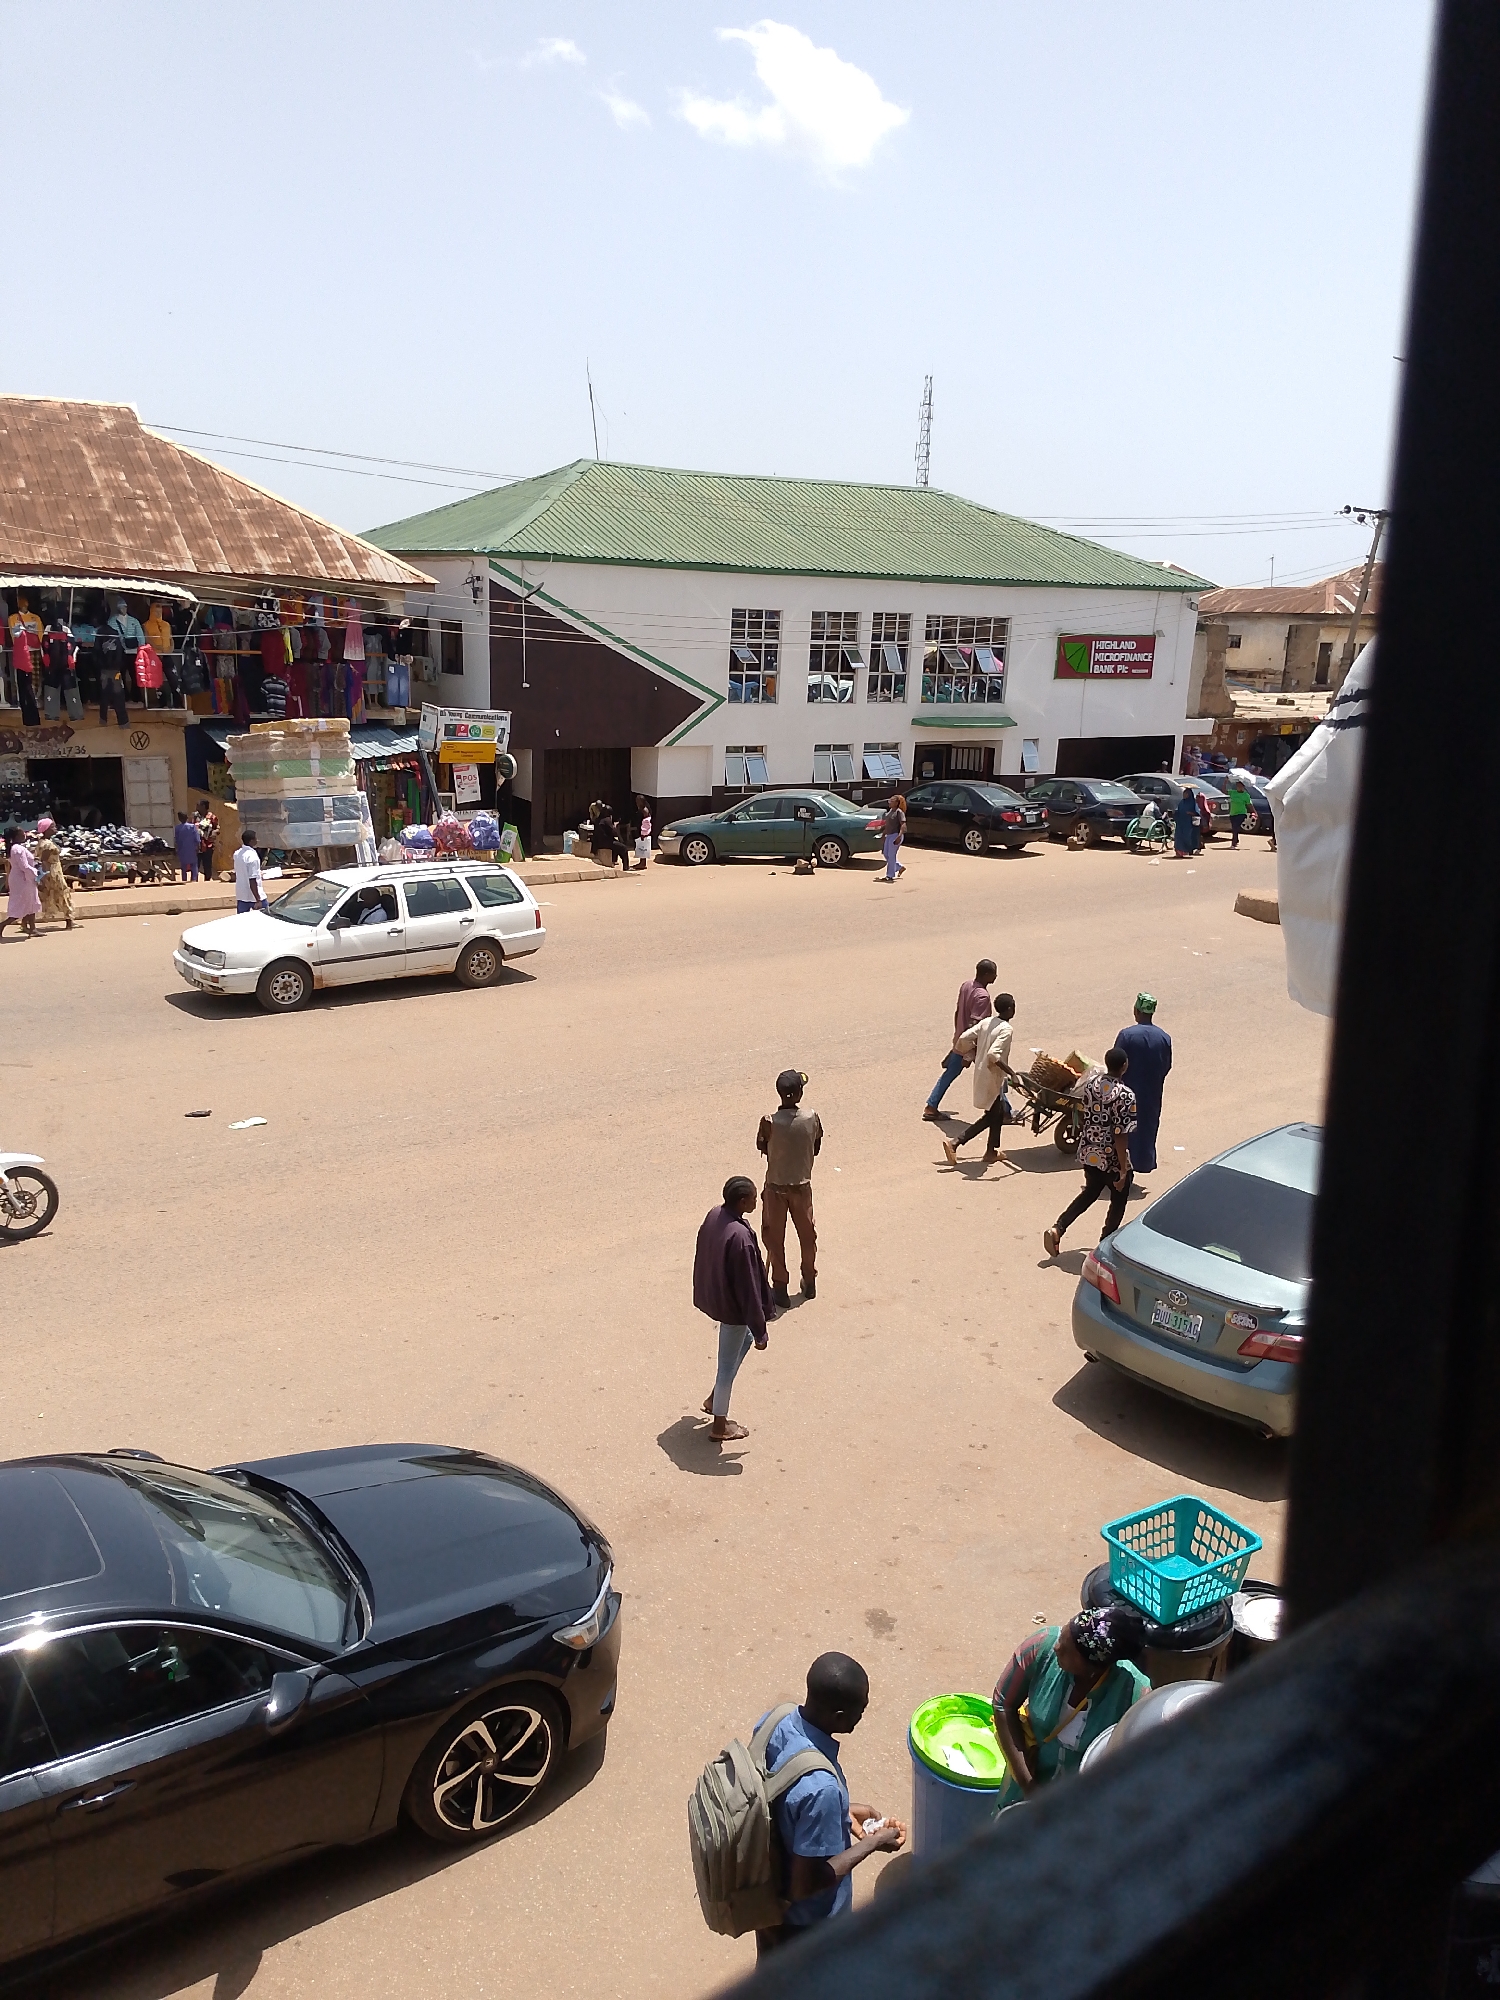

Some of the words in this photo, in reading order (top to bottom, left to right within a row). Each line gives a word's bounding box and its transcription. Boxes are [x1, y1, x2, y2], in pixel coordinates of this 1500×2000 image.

[1096, 641, 1136, 649] HIGHLAND
[1094, 653, 1152, 661] MICROFINANCE
[1093, 665, 1115, 673] BANK
[465, 713, 508, 721] Communications
[462, 774, 478, 782] POS
